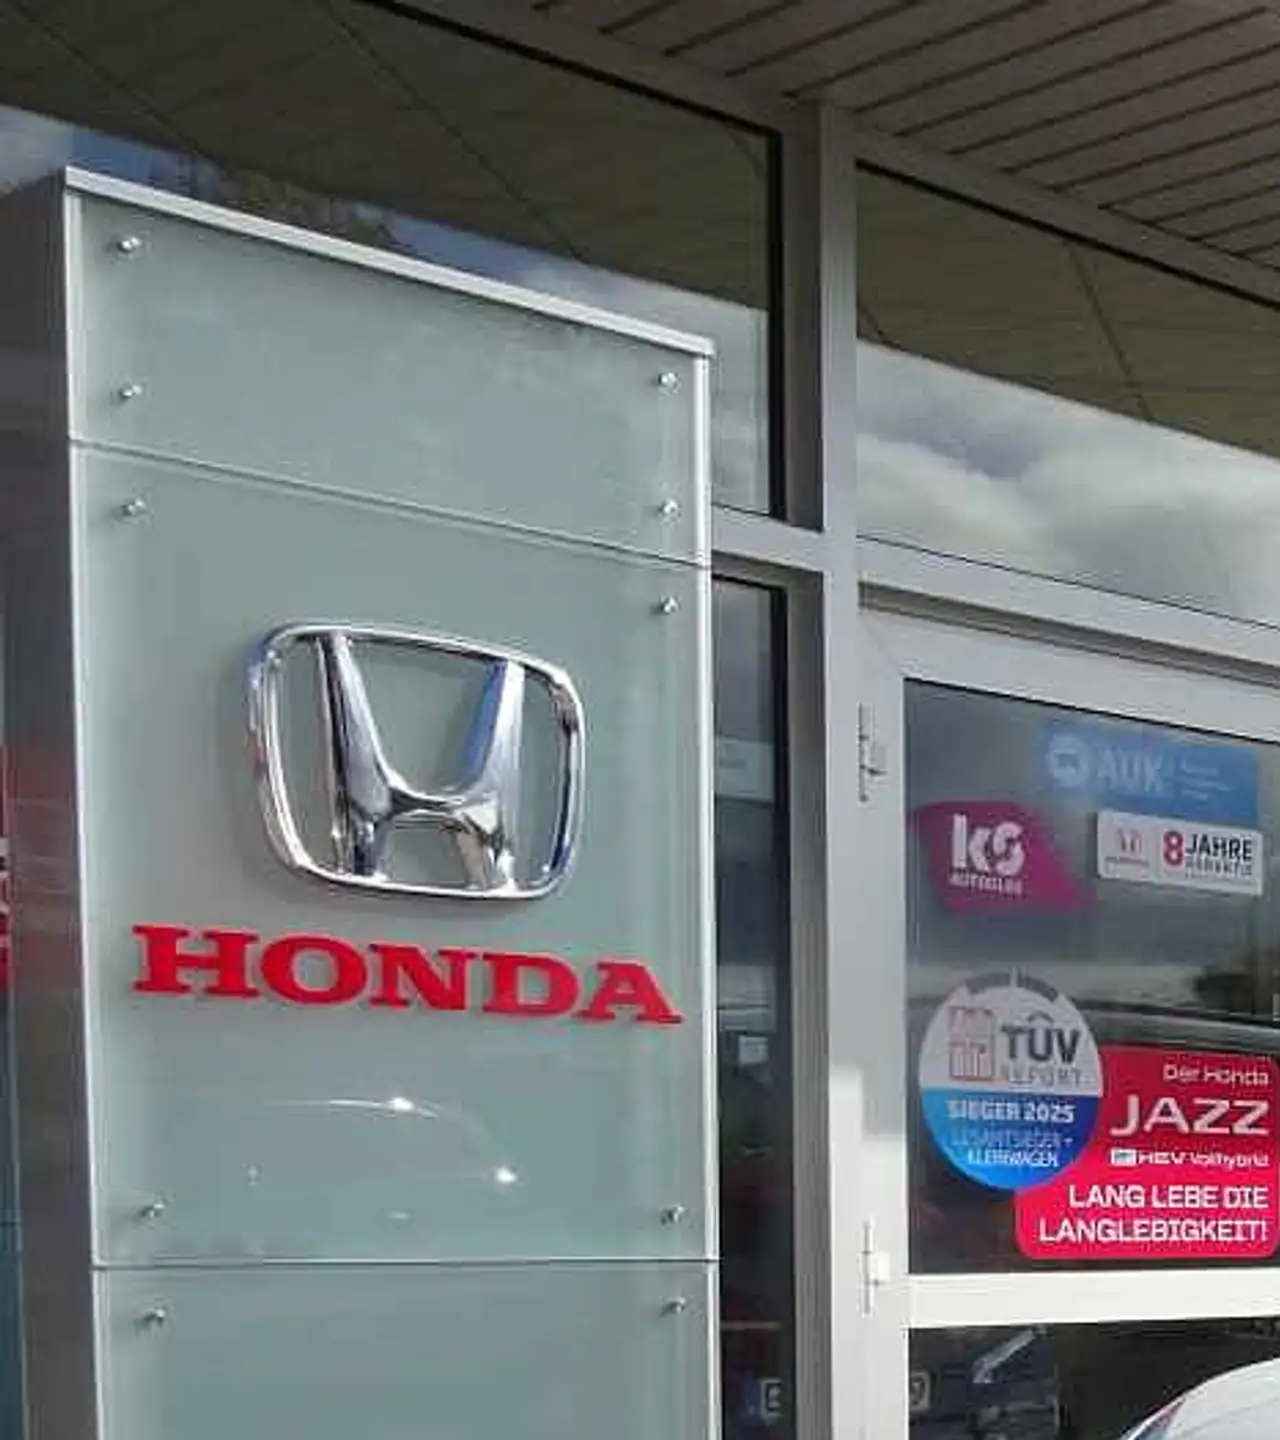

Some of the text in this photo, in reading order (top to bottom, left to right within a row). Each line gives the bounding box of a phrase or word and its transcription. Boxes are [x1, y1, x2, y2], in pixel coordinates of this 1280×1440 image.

[1162, 830, 1253, 867] 8 JAHRE
[132, 924, 687, 1025] HONDA
[1001, 1011, 1081, 1064] TÜV
[1163, 1064, 1270, 1086] Der Honda
[947, 1099, 1077, 1124] SIEGER 2025
[1109, 1094, 1271, 1137] JAZZ
[1069, 1185, 1270, 1209] LANG LEBE DIE
[1039, 1217, 1268, 1243] LANGLEBIGKEIT!
